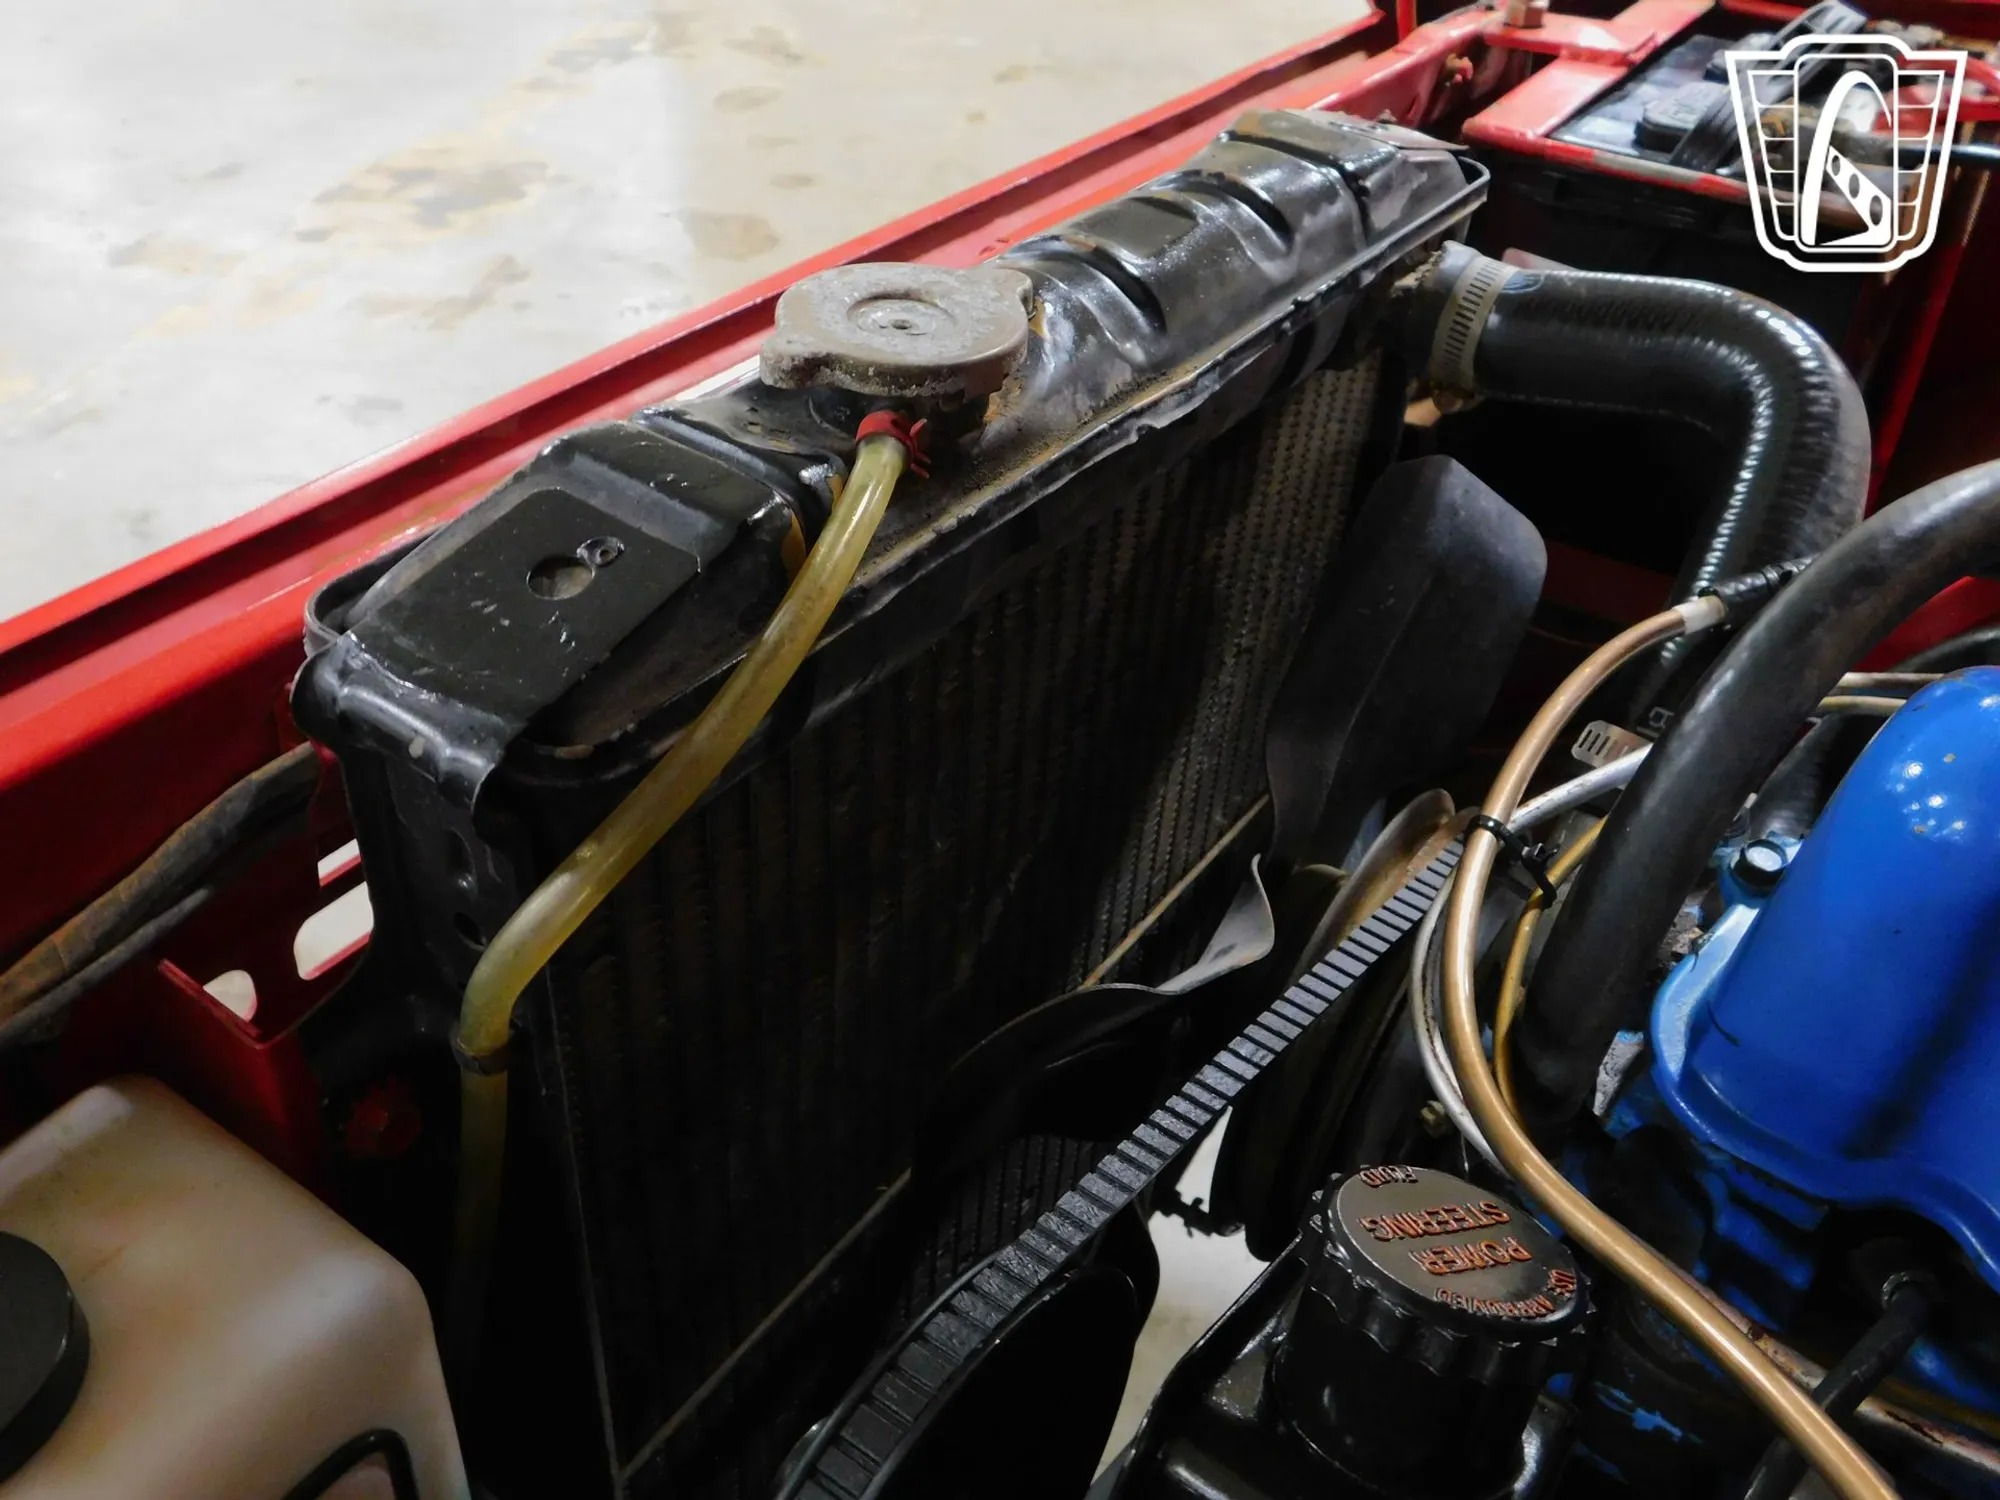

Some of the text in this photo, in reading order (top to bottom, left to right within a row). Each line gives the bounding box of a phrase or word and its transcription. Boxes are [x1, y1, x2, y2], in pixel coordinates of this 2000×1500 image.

[1360, 1165, 1418, 1188] FLUID
[1358, 1200, 1511, 1242] STEERING
[1408, 1236, 1532, 1275] POWER
